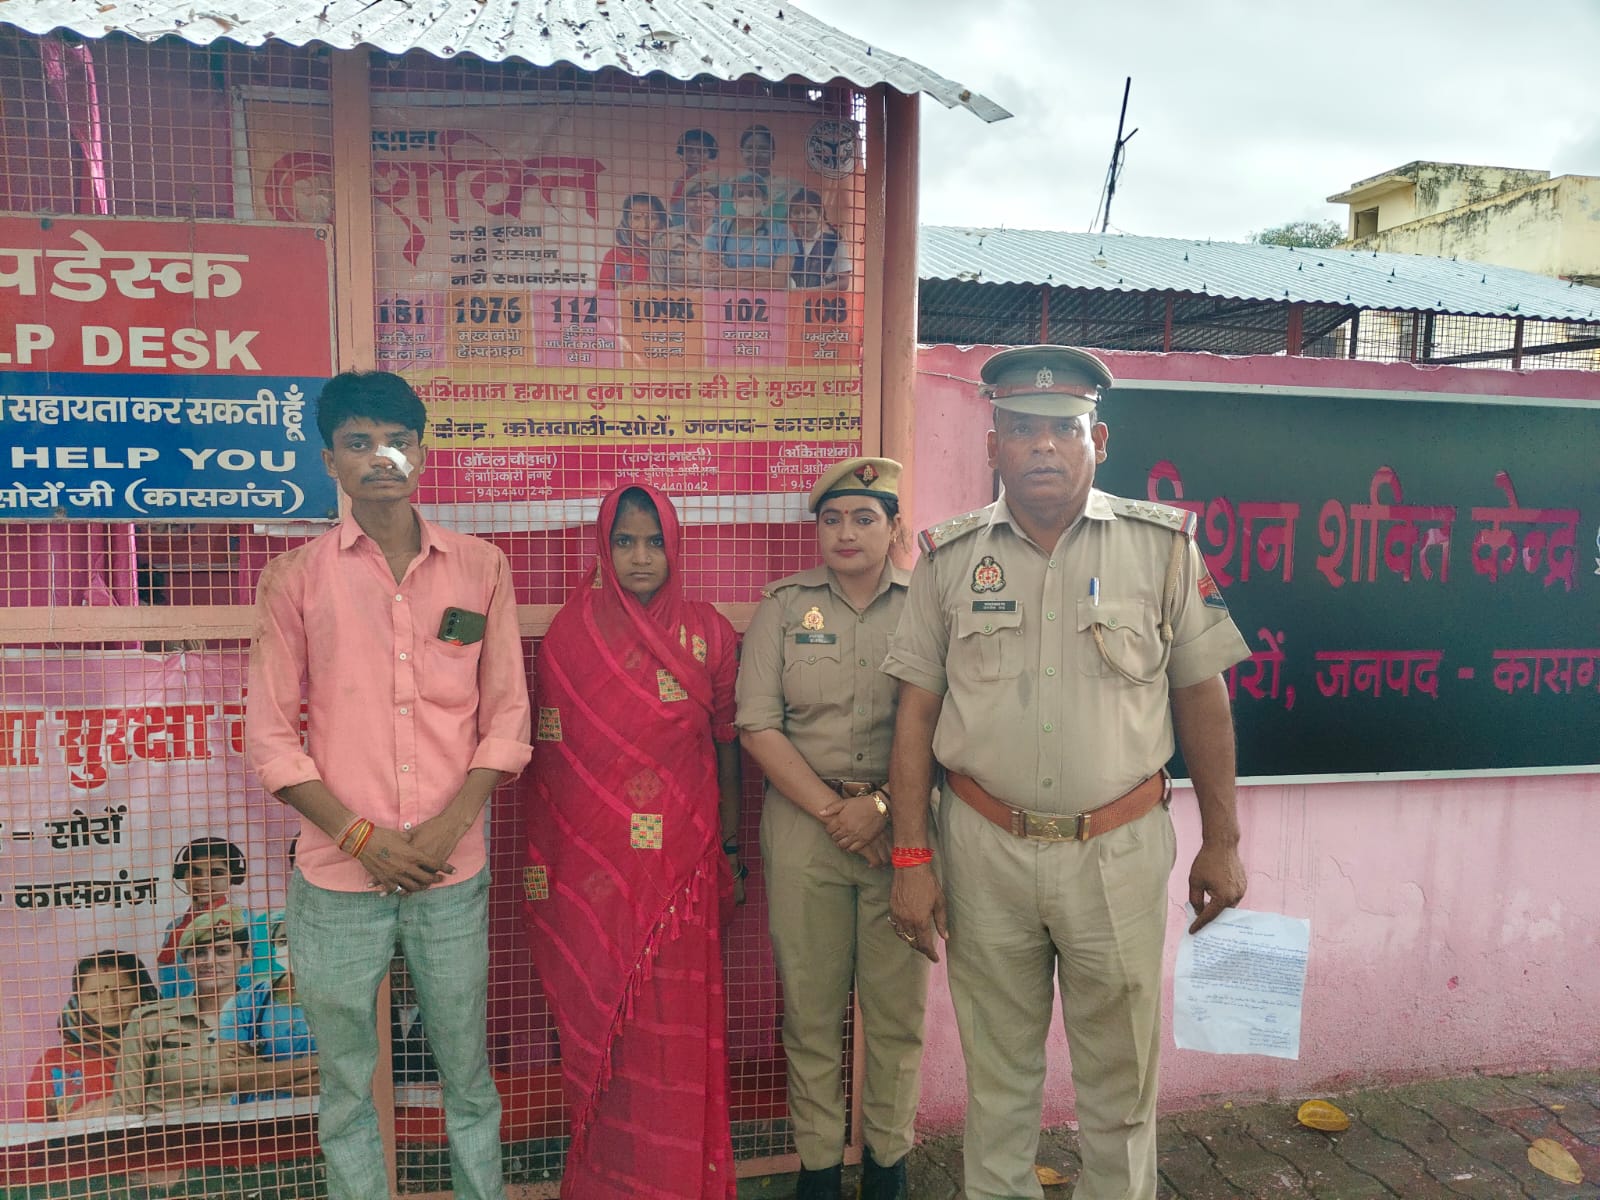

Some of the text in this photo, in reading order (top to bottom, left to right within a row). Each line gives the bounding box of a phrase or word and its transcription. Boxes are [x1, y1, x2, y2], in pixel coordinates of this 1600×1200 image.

[46, 229, 249, 302] डेस्क
[380, 299, 425, 324] 181
[455, 296, 522, 324] 1076
[551, 296, 599, 323] 112
[724, 298, 769, 323] 102
[803, 297, 848, 323] 108
[82, 325, 262, 371] DESK
[512, 383, 579, 403] हमारा
[630, 382, 692, 400] जगत
[698, 374, 729, 400] की
[735, 374, 760, 401] हो
[8, 396, 129, 424] सहायता
[130, 397, 183, 424] कर
[185, 388, 279, 426] सकती
[281, 383, 305, 442] हूँ
[11, 446, 297, 472] HELP YOU
[66, 480, 115, 507] जी
[124, 477, 304, 514] (कासगंज)
[1317, 465, 1457, 588] शक्ति
[1472, 470, 1580, 592] केन्द्र
[1315, 648, 1444, 699] जनपद
[1493, 648, 1600, 695] कासग
[55, 704, 216, 789] सुरक्षा
[45, 805, 127, 850] सोरों
[14, 869, 160, 909] कासगंज
